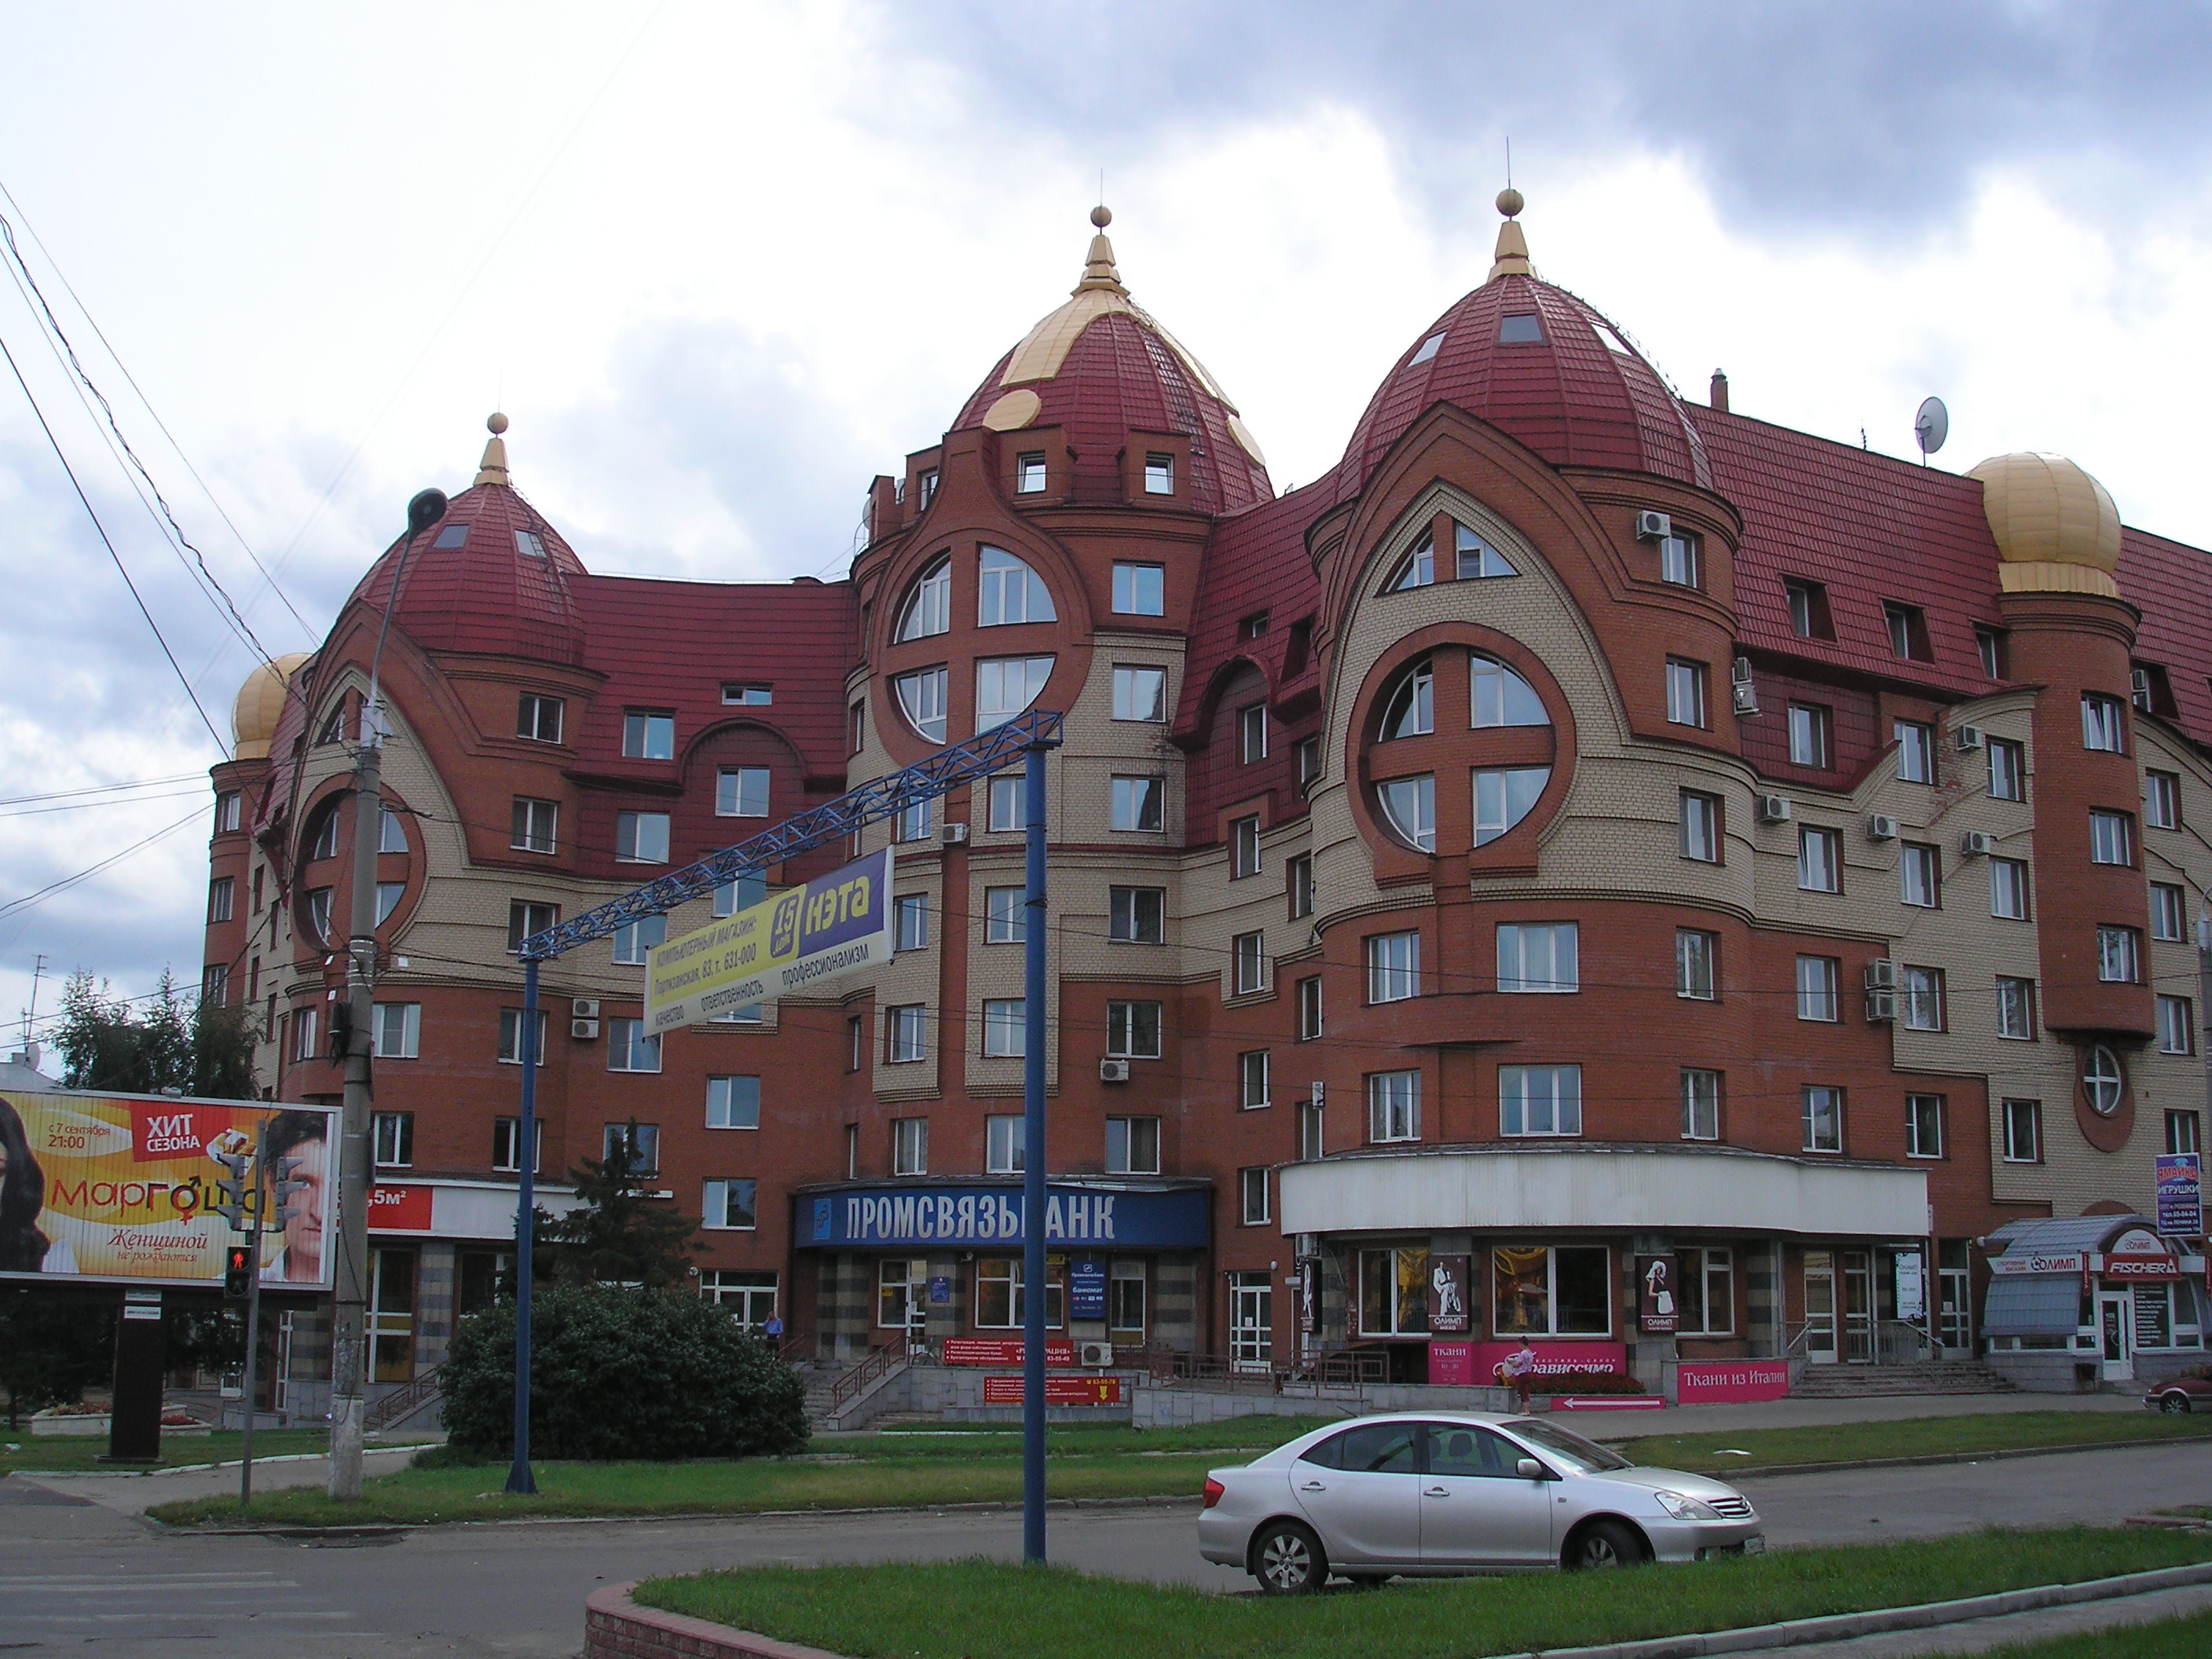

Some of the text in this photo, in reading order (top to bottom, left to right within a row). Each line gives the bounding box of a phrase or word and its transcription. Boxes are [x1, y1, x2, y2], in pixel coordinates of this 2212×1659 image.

[775, 899, 797, 935] 15
[655, 943, 869, 1027] качество ответственность профессионализм
[49, 1122, 111, 1137] с 7 сентября
[146, 1114, 193, 1138] ХИТ
[48, 1134, 85, 1148] 21:00
[146, 1135, 200, 1152] СЕЗОНА
[2158, 1185, 2199, 1194] ИГРУШКИ
[108, 1229, 207, 1251] Женщиной
[117, 1251, 198, 1264] не рождаются
[2039, 1258, 2076, 1270] ОЛИМП
[2110, 1262, 2166, 1273] FISCHER
[1684, 1371, 1785, 1386] Ткани из Италии
